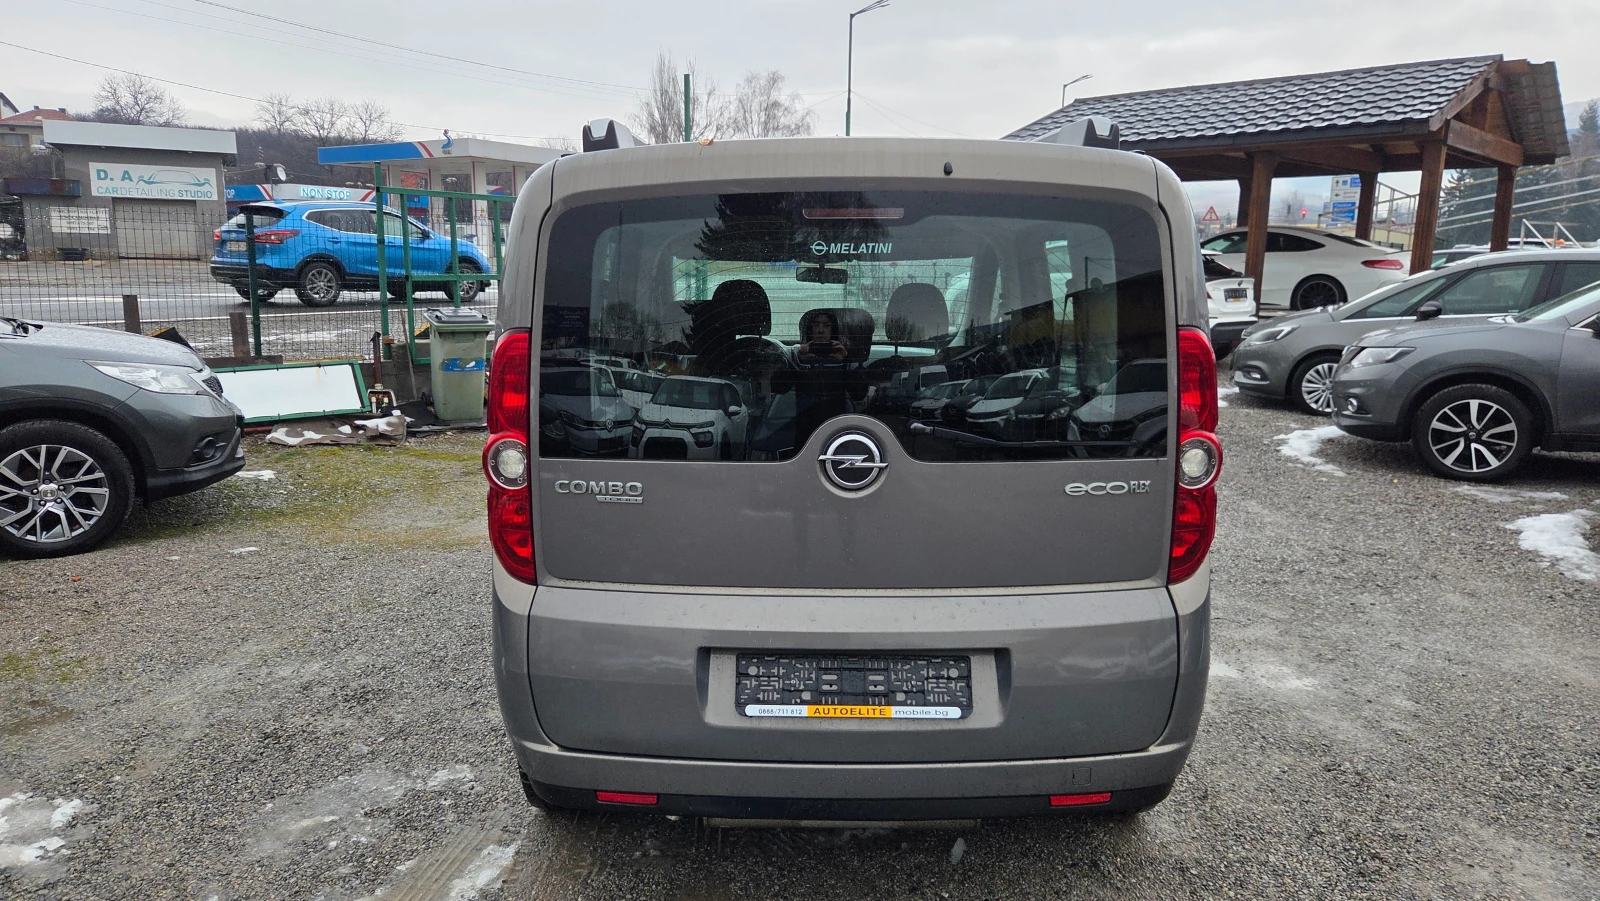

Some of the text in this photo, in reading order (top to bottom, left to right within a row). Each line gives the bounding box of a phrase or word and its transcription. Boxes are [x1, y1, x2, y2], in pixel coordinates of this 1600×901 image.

[96, 168, 134, 182] D. A
[177, 189, 213, 199] STUDIO
[300, 187, 352, 200] NON STOP
[829, 242, 893, 254] MELATINI
[554, 480, 643, 495] COMBO
[813, 707, 887, 716] AUTOELITE
